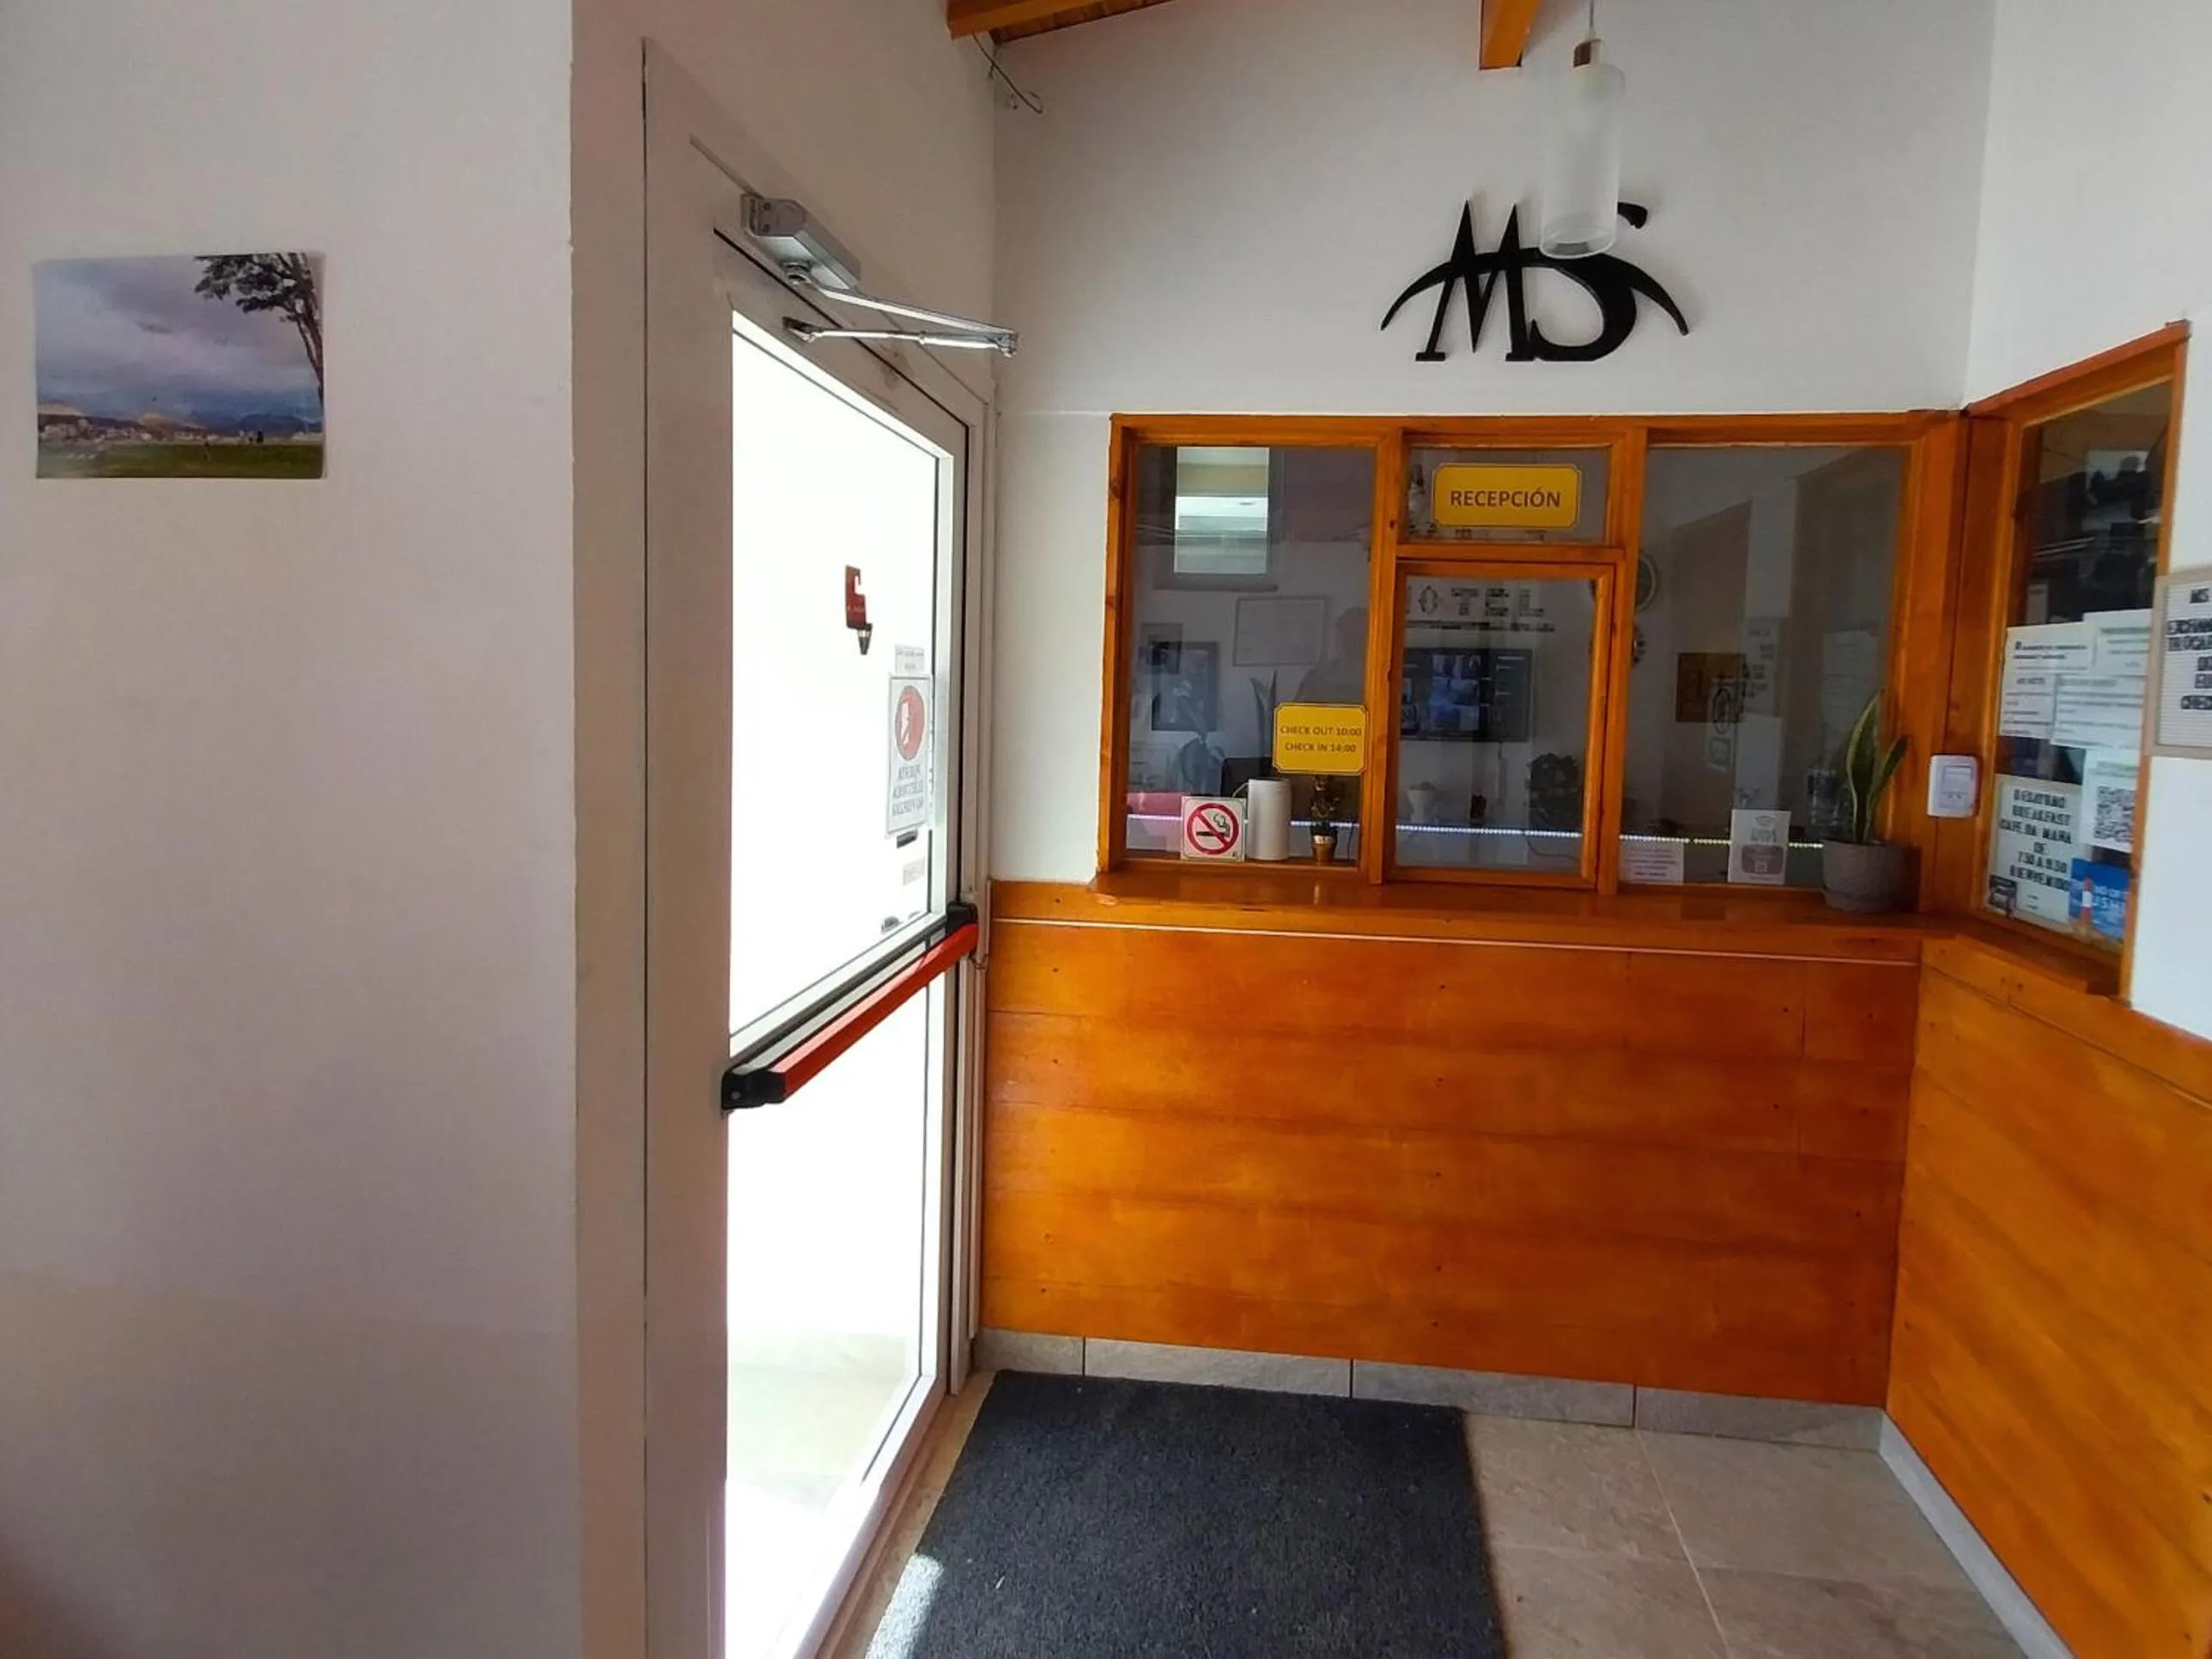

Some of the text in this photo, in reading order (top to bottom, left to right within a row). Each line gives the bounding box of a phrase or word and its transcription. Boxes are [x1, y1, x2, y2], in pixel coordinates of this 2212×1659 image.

[1450, 486, 1561, 507] RECEPCIÓN
[1407, 585, 1545, 617] OTEL
[1279, 725, 1362, 737] CHECK OUT 10:00
[1285, 742, 1357, 753] CHECK IN 14:00
